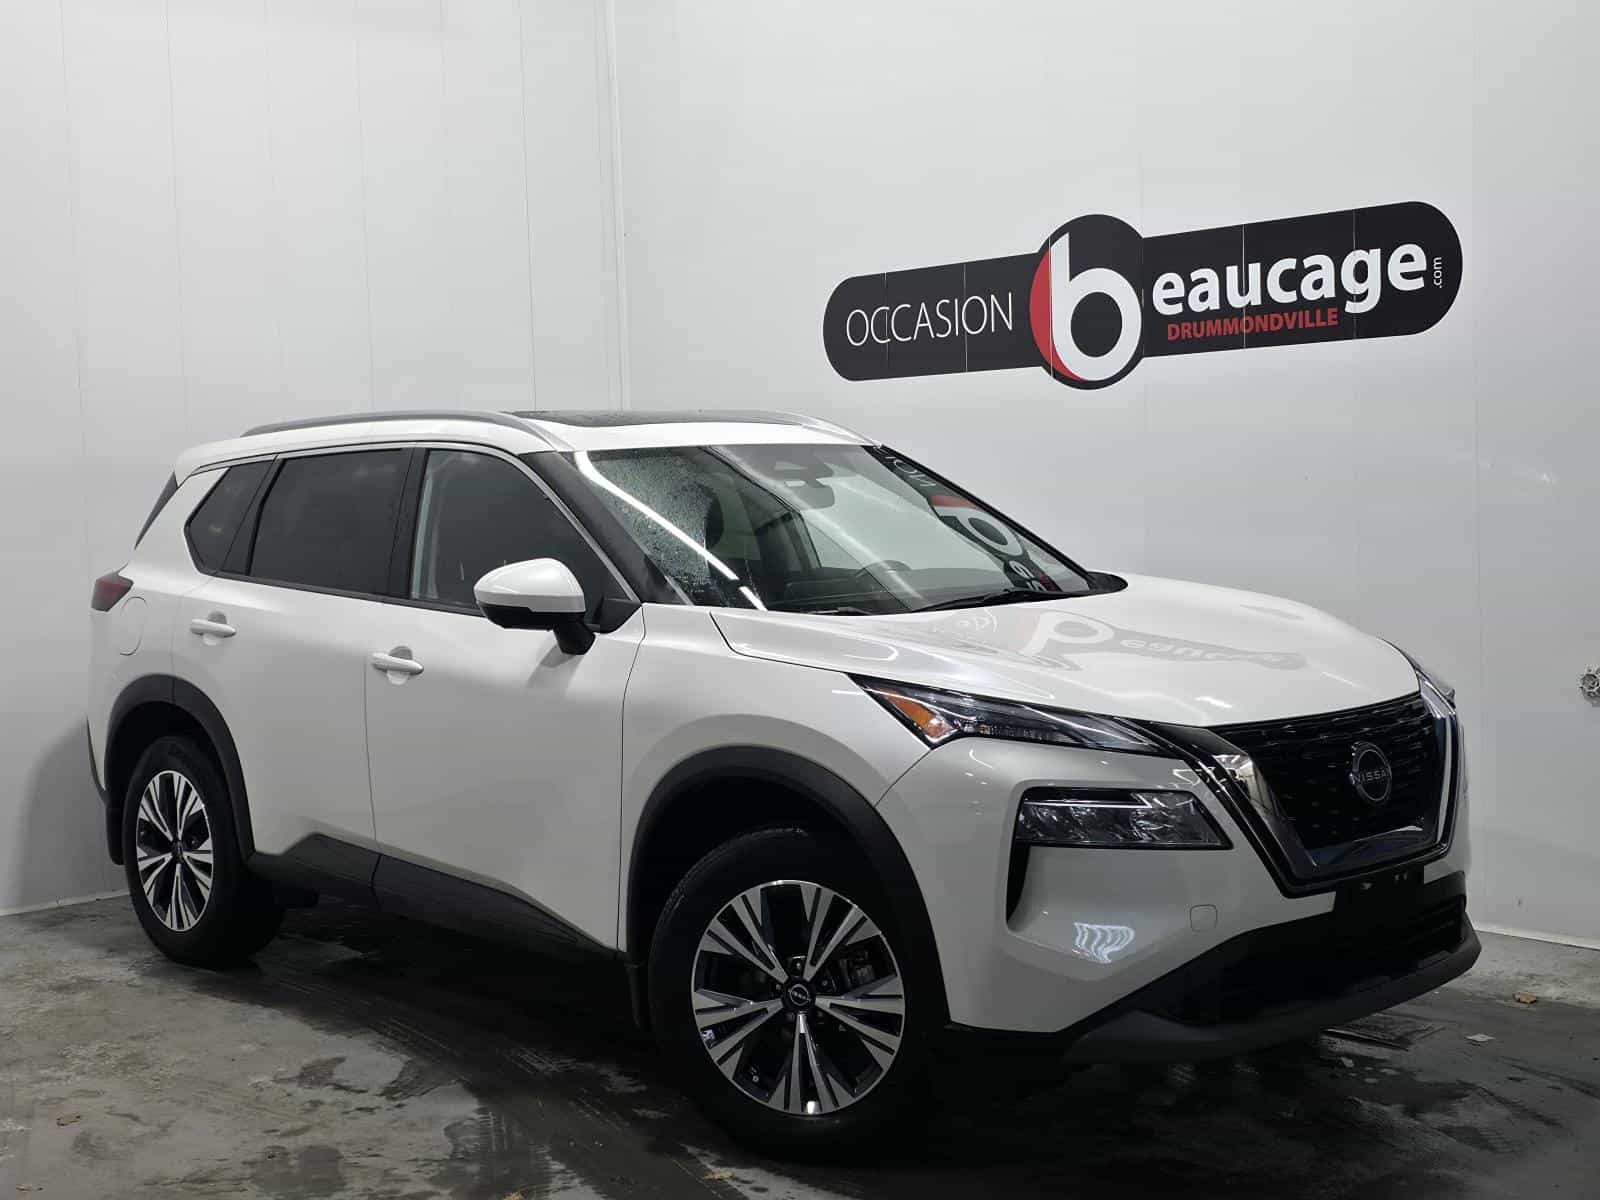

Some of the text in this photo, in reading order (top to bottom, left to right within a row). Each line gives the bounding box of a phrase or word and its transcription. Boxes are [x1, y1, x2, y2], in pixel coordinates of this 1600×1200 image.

[1433, 256, 1444, 289] .com
[846, 293, 1014, 347] OCCASION
[1166, 308, 1338, 341] DRUMMONDVILLE
